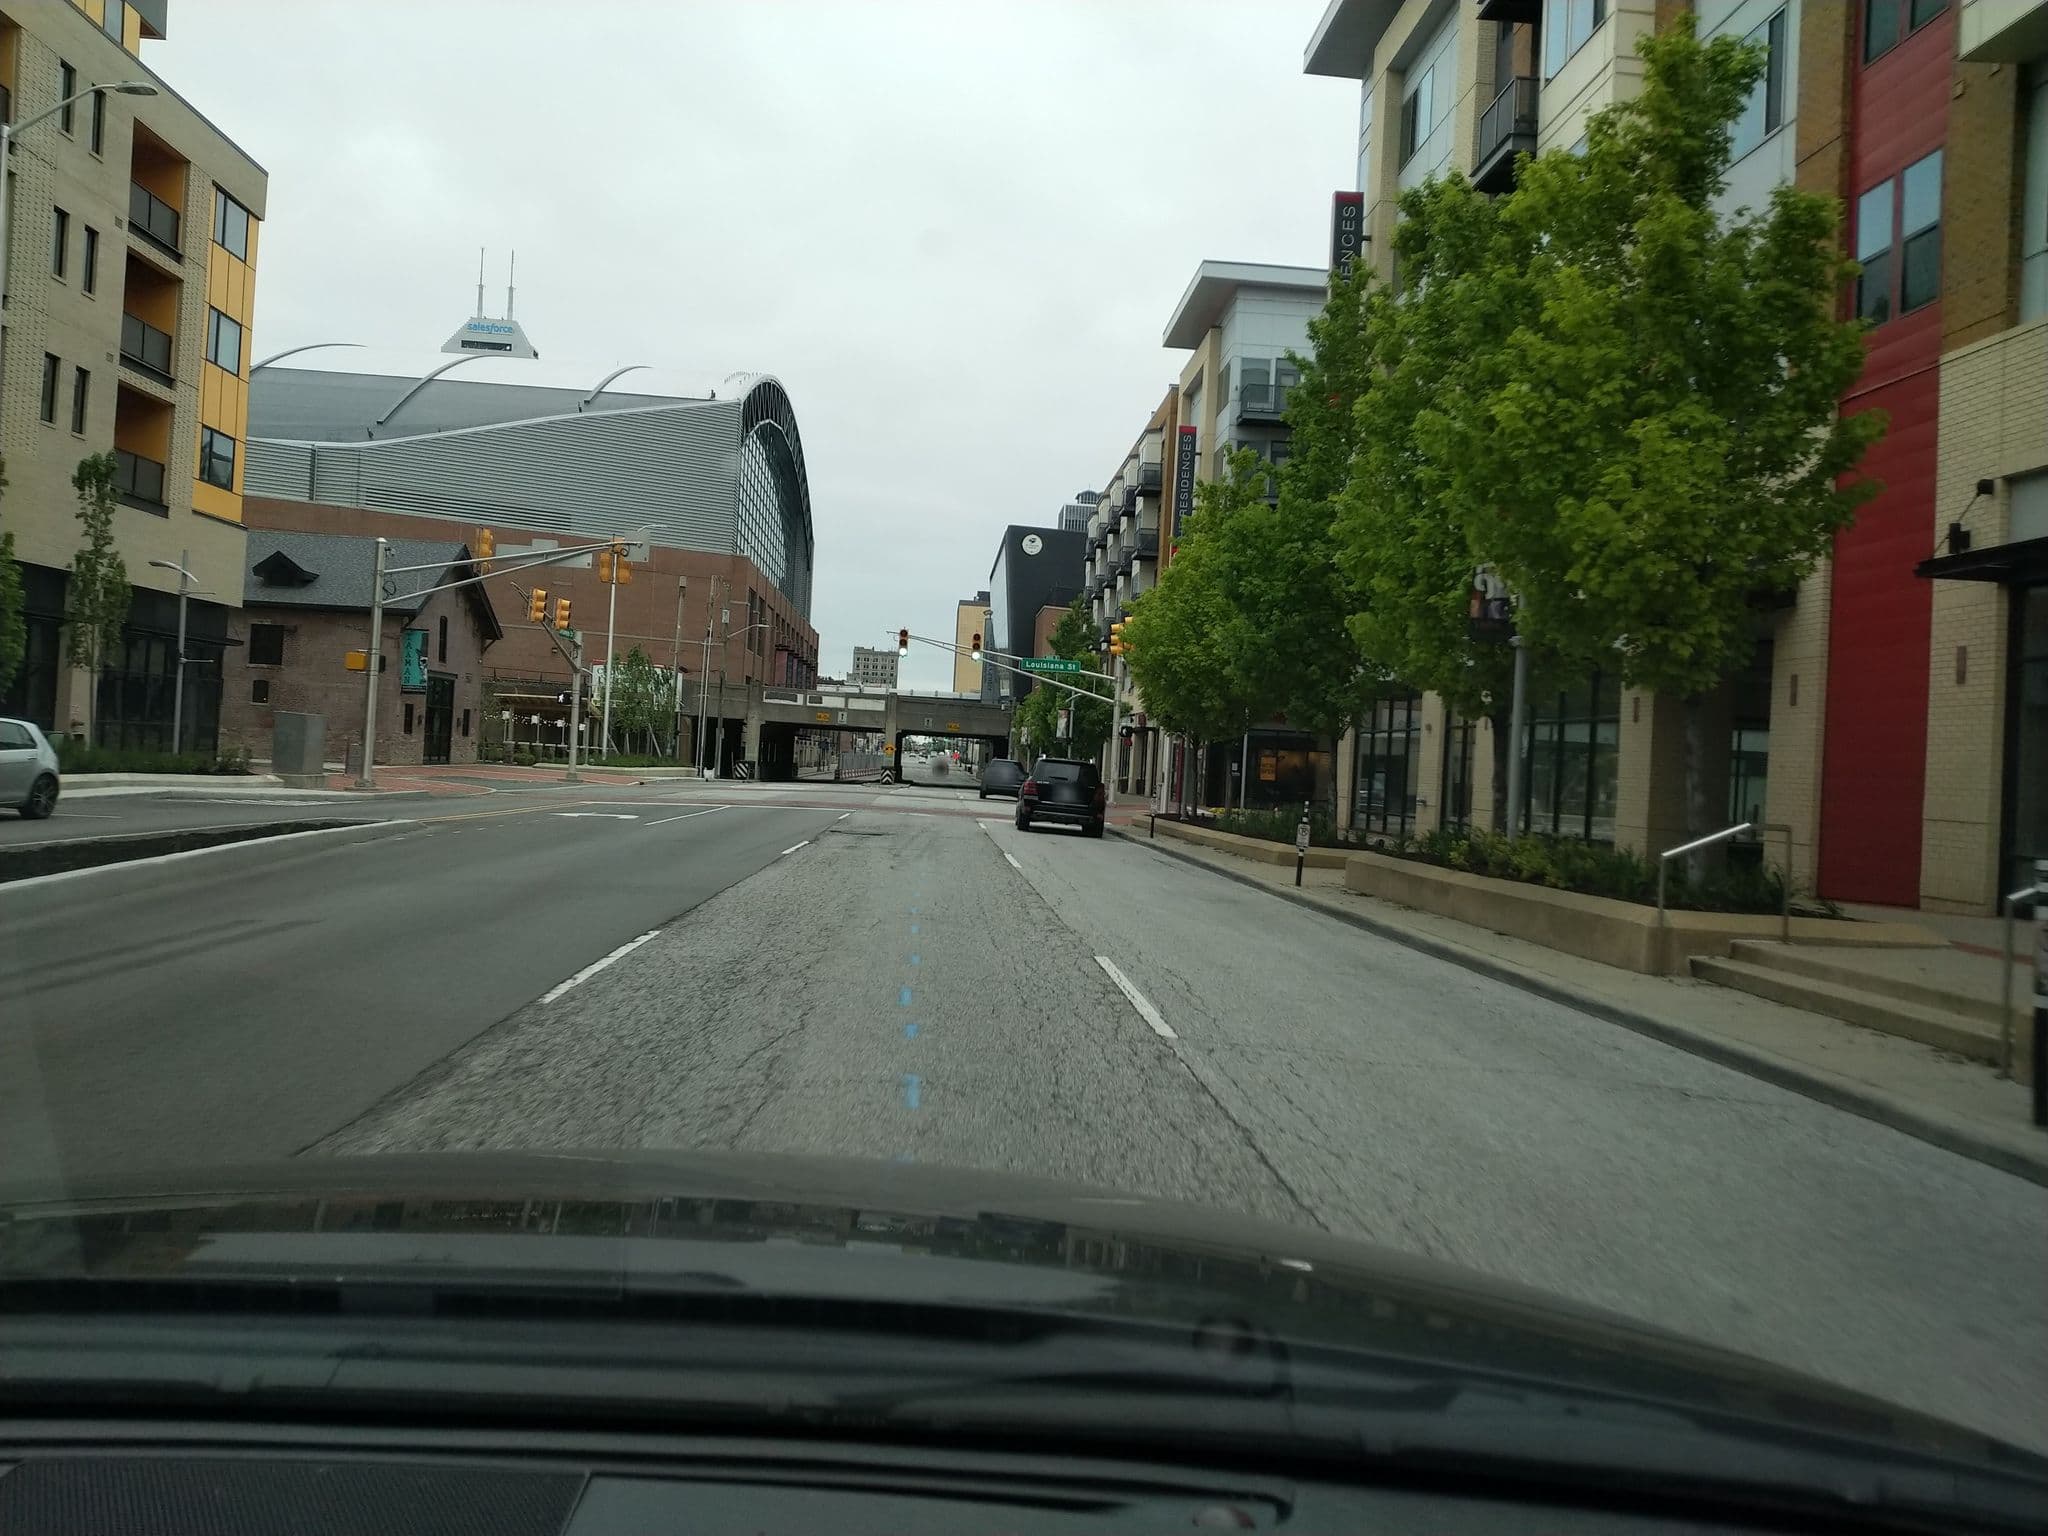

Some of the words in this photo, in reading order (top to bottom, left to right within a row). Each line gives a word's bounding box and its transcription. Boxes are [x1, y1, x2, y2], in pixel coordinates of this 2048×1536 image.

[467, 322, 513, 334] salesforce
[1179, 434, 1193, 516] RESIDENCES
[1025, 661, 1065, 670] Louisiana
[1067, 663, 1076, 671] St
